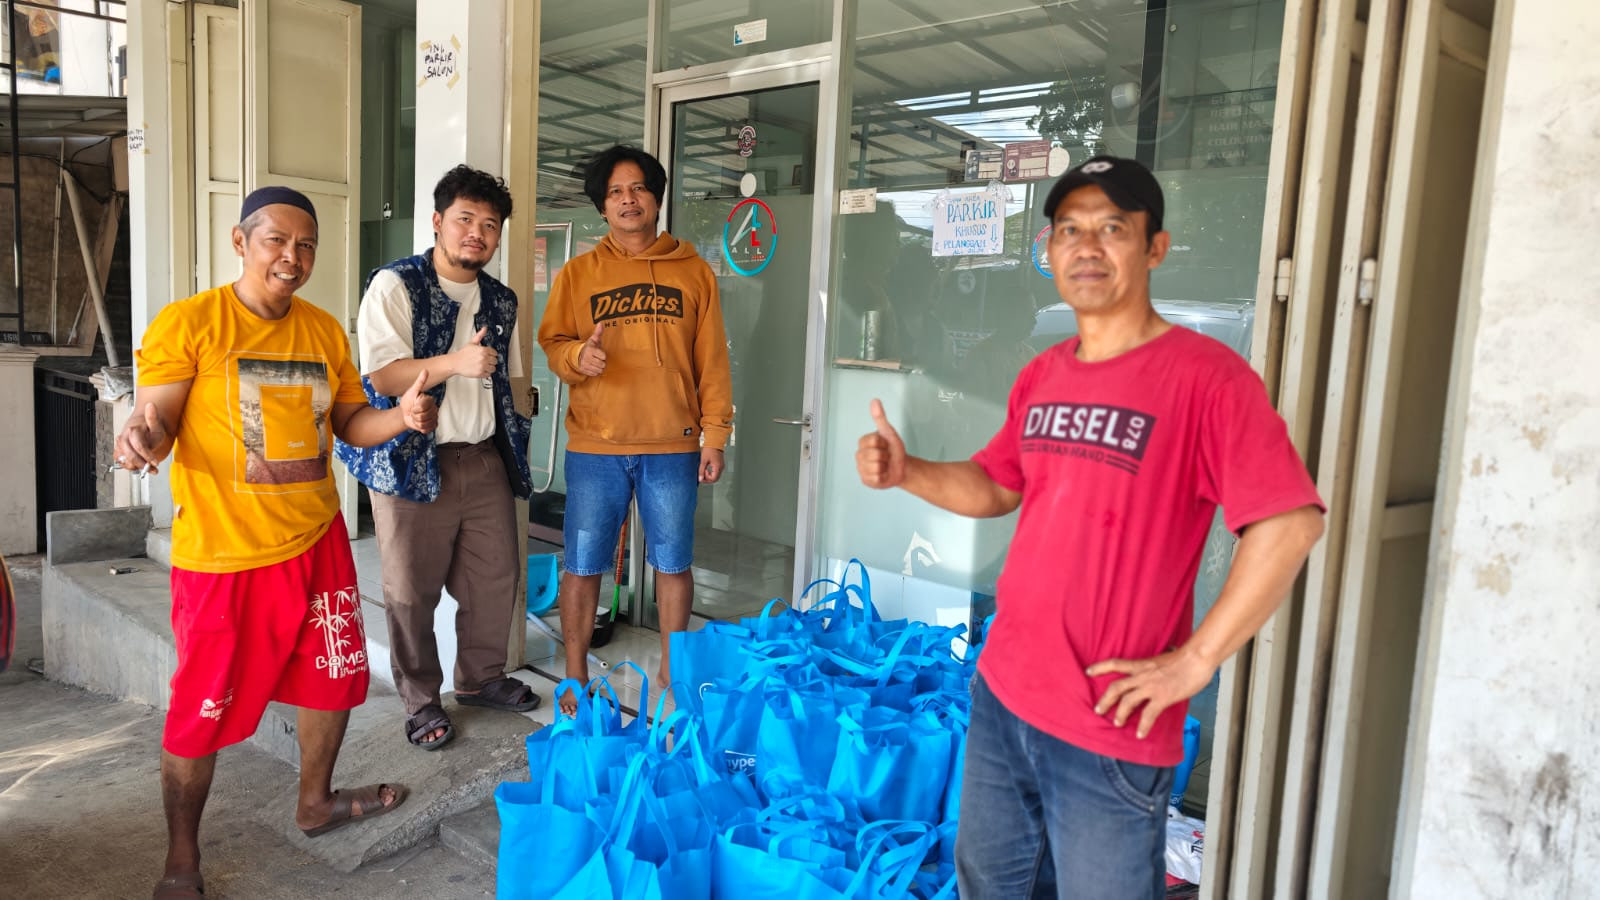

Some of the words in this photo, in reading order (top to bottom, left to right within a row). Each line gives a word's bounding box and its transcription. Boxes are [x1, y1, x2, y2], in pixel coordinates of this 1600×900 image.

[424, 51, 453, 64] PARKIR
[427, 65, 453, 78] SALON
[947, 200, 997, 223] PARKIR
[593, 287, 680, 321] Dickies
[624, 315, 677, 326] ORIGINAL
[1024, 405, 1119, 446] DIESEL
[1121, 416, 1146, 451] 078
